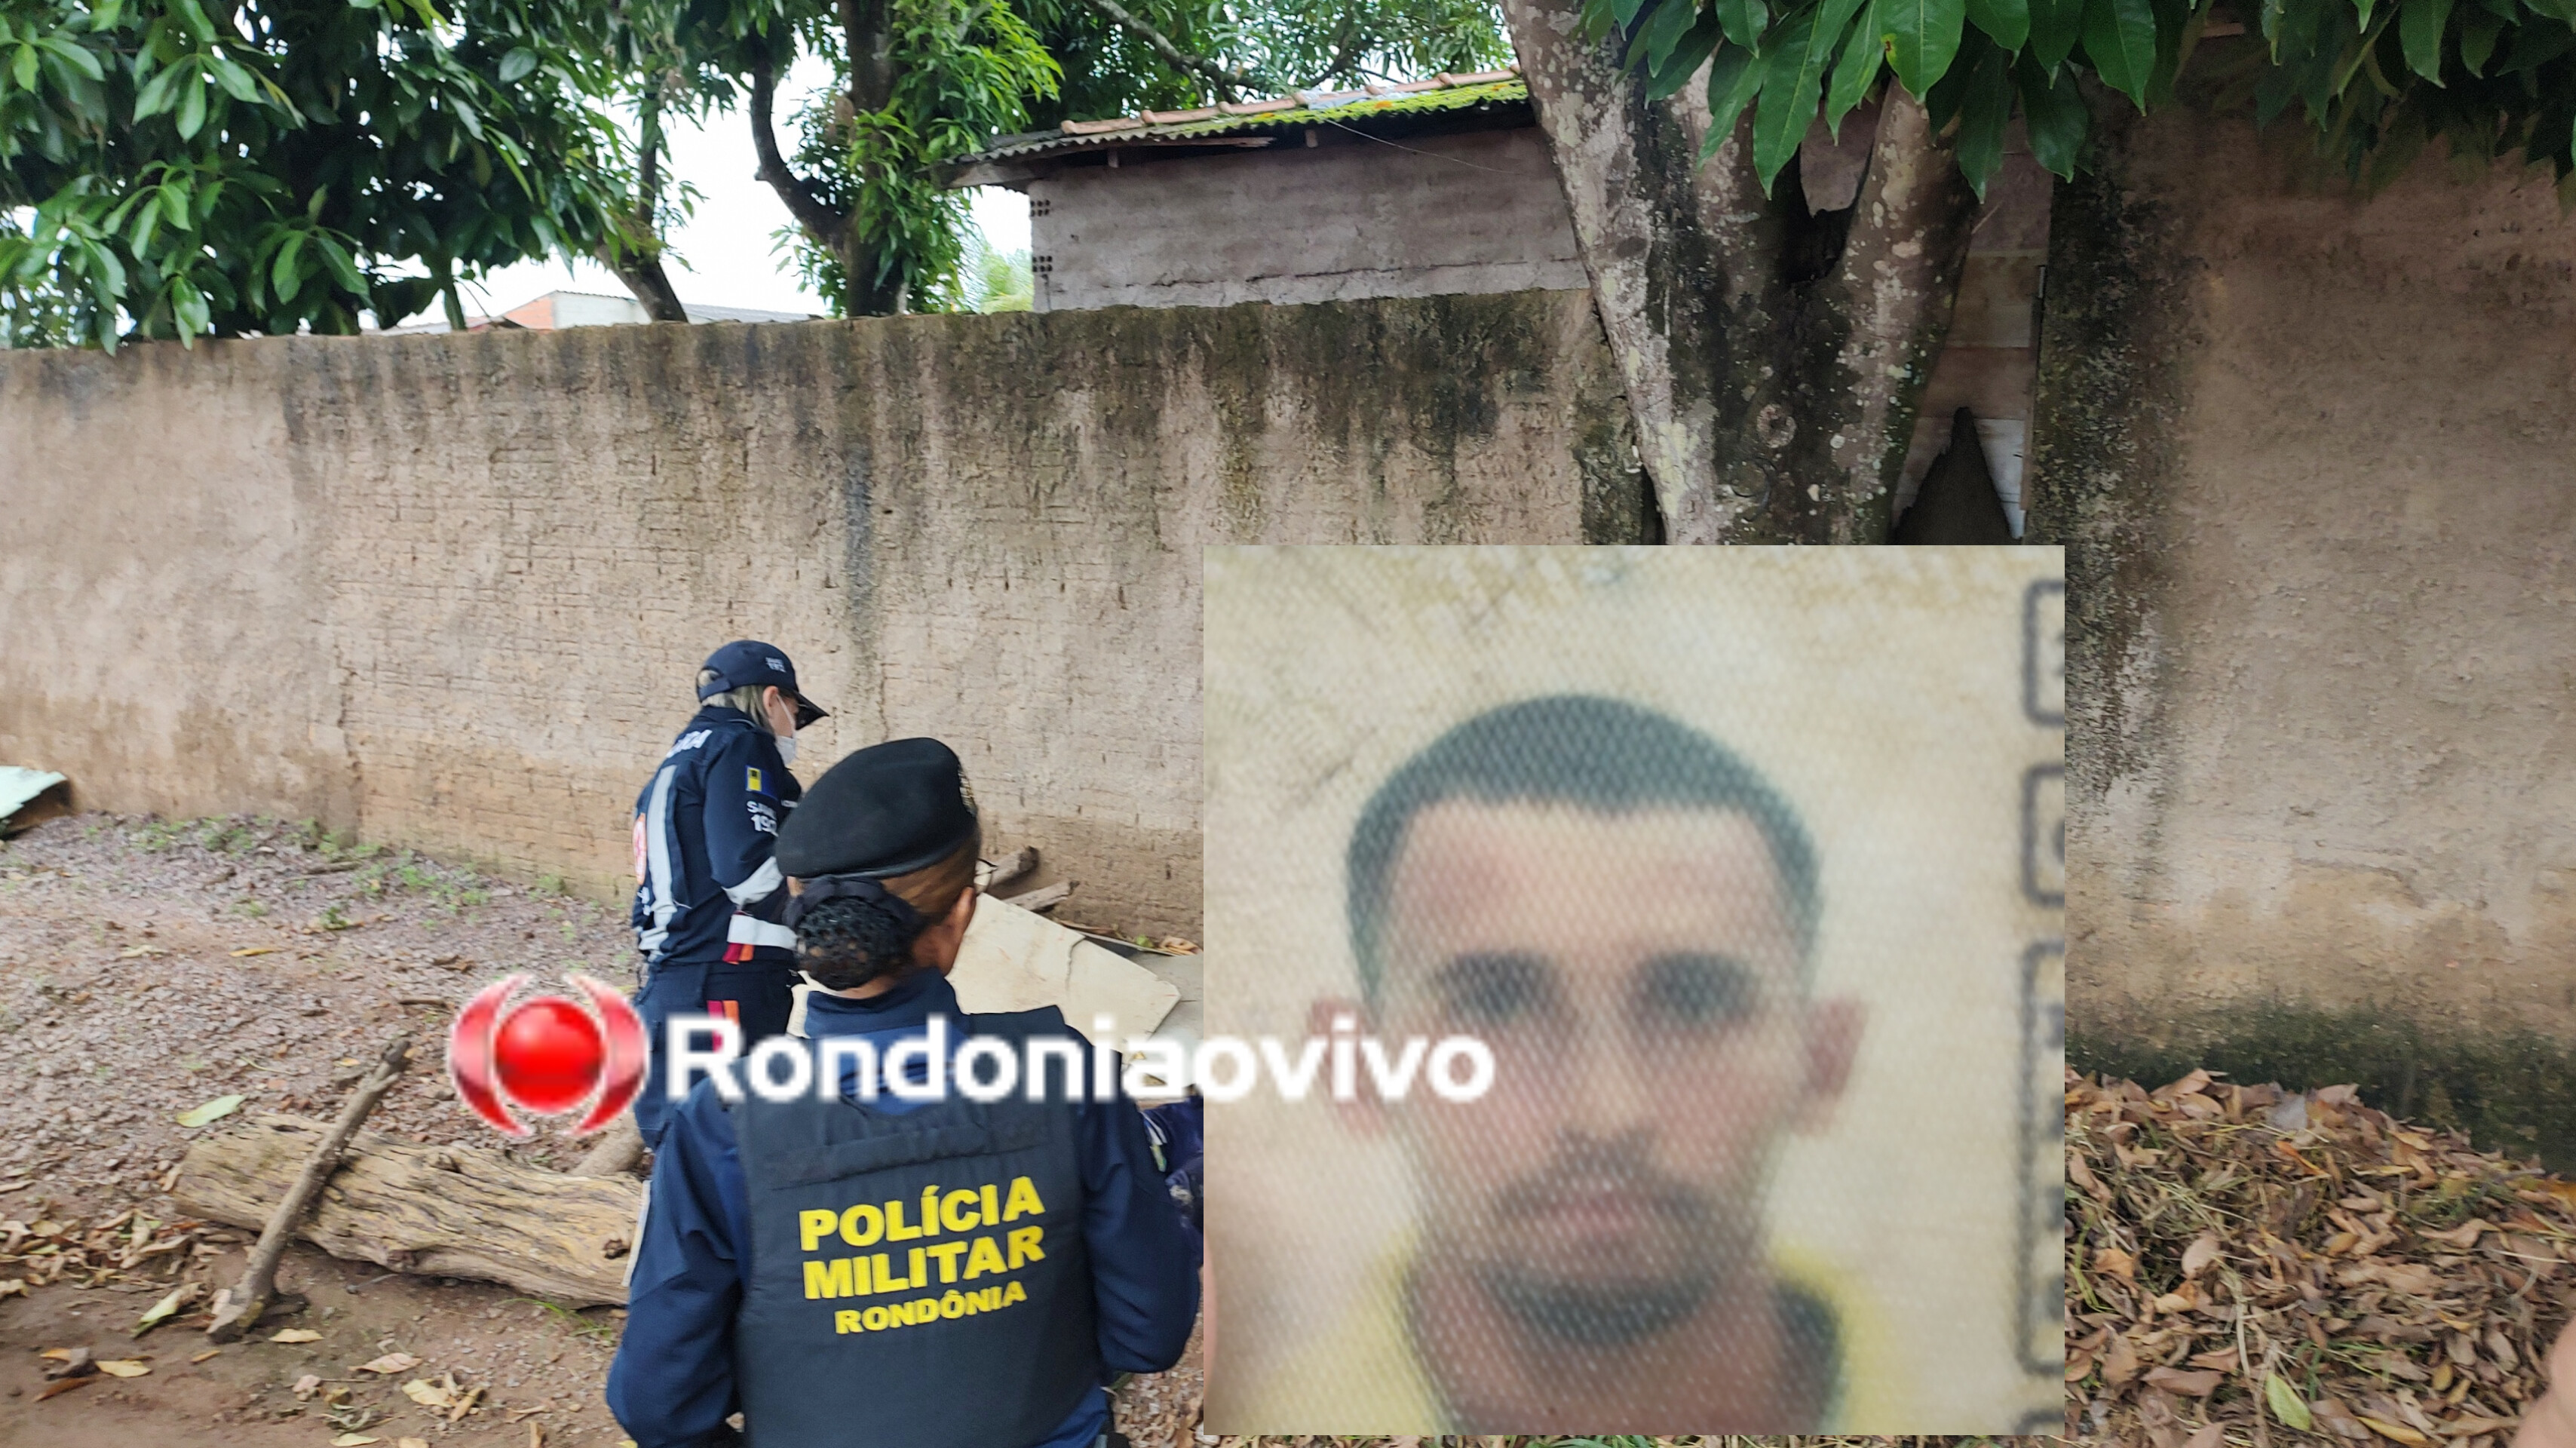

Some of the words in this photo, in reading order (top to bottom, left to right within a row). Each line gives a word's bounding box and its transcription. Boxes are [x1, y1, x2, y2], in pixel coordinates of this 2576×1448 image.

[799, 1176, 1046, 1251] POLÍCIA
[802, 1225, 1046, 1299] MILITAR
[834, 1280, 1027, 1334] RONDÔNIA
